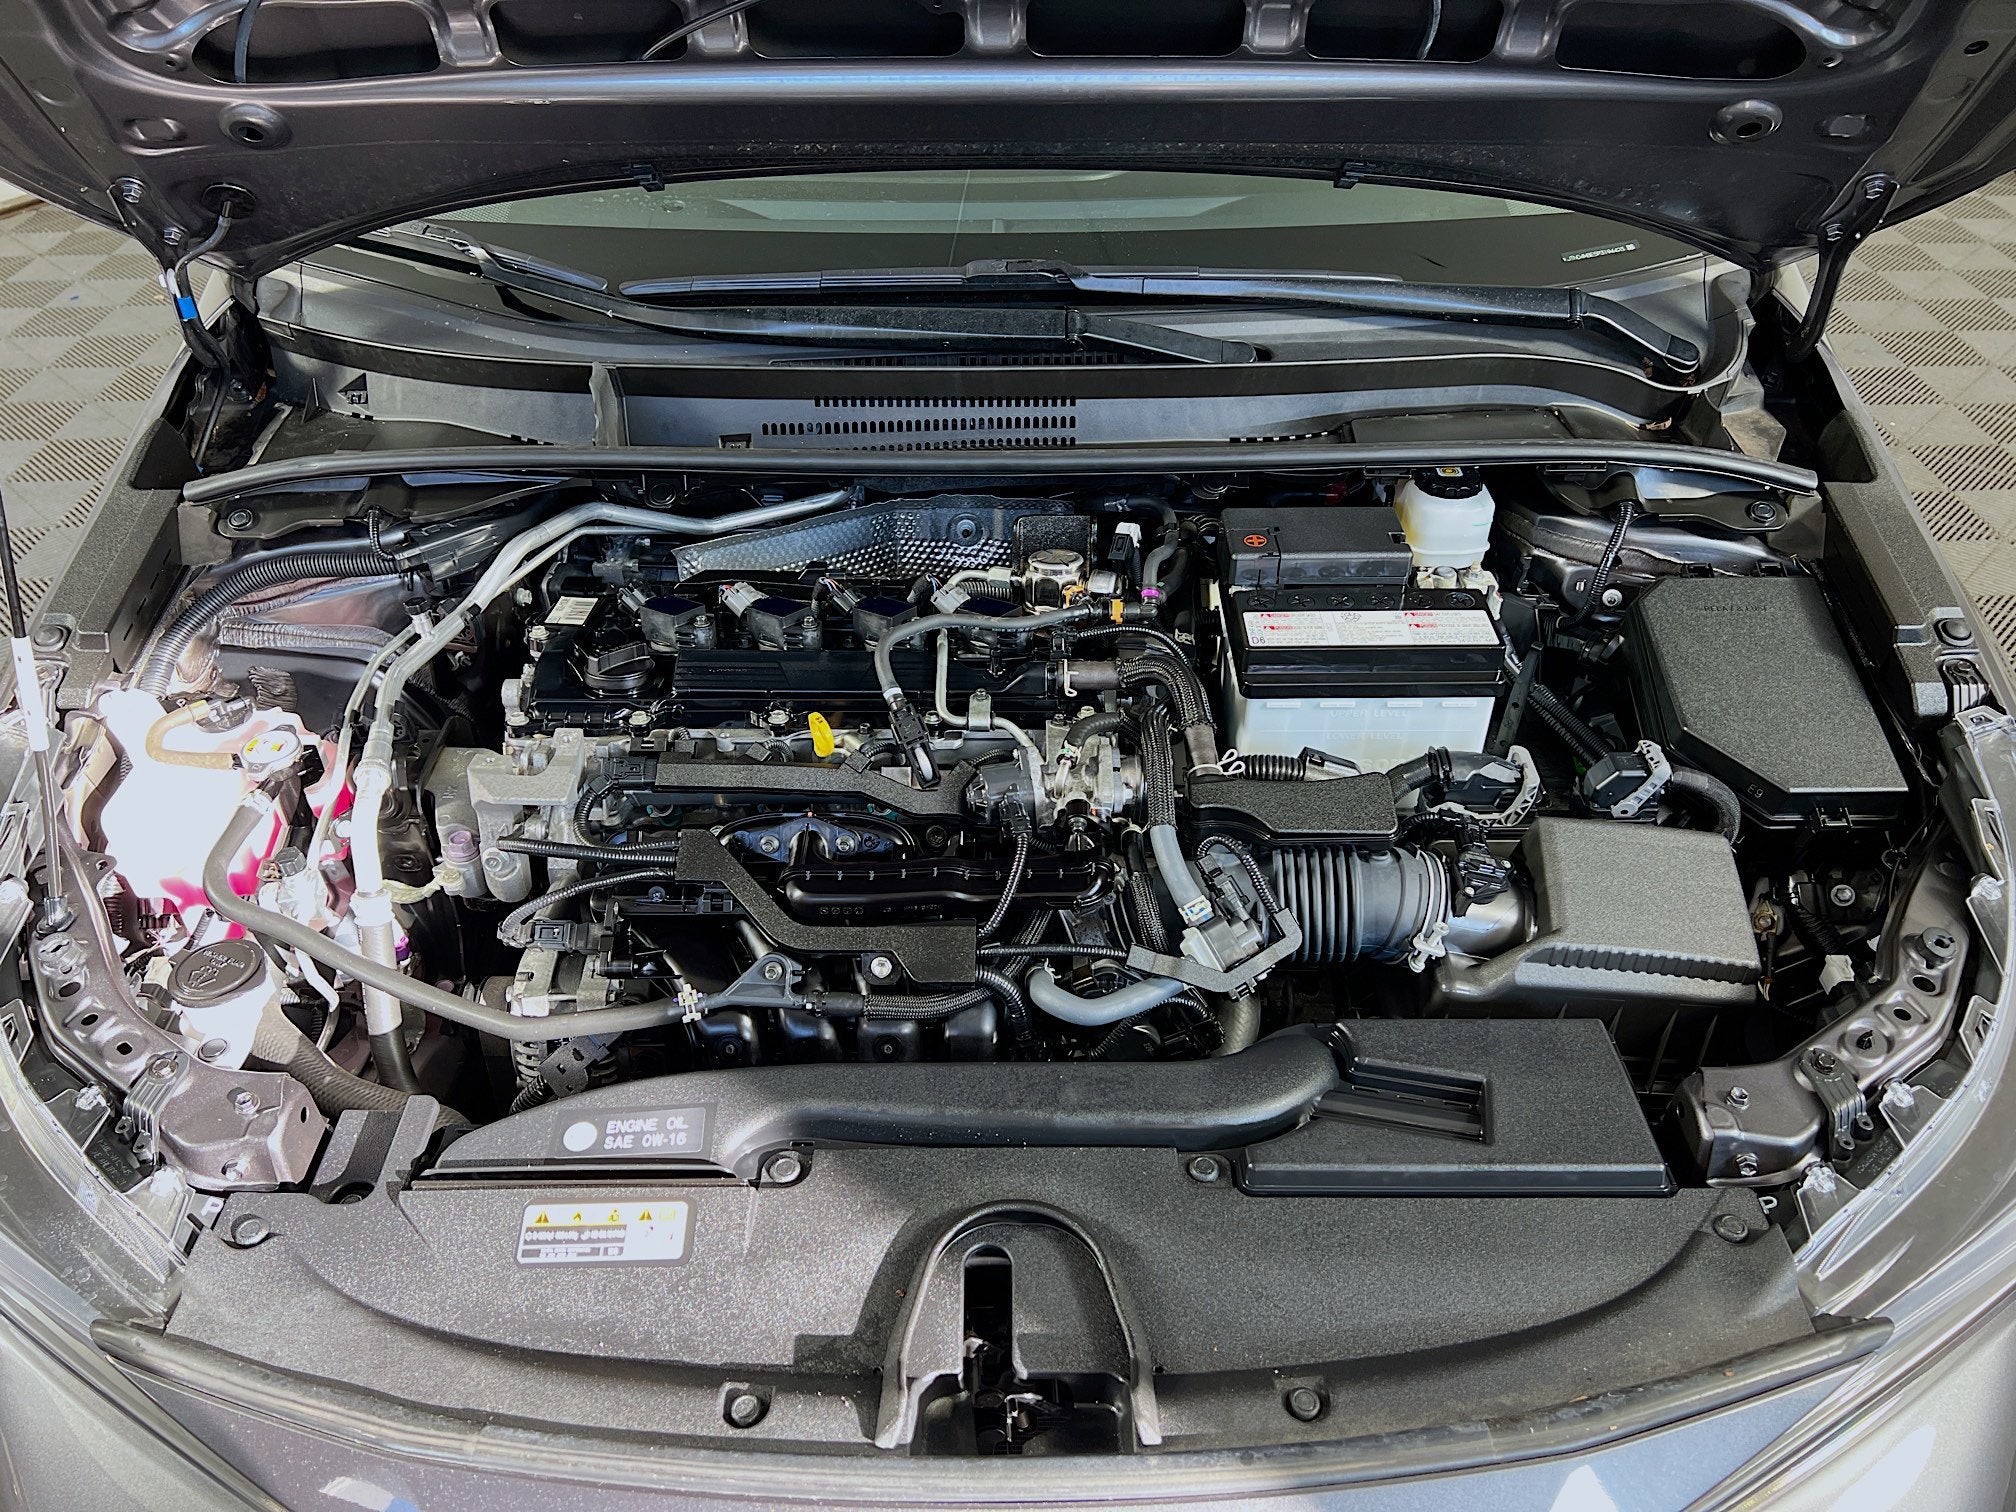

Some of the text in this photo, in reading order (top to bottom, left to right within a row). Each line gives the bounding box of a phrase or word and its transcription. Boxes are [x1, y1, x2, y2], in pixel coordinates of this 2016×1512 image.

[1374, 708, 1409, 718] LEVEL
[605, 1115, 689, 1135] ENGINE OIL
[603, 1134, 634, 1150] SAE
